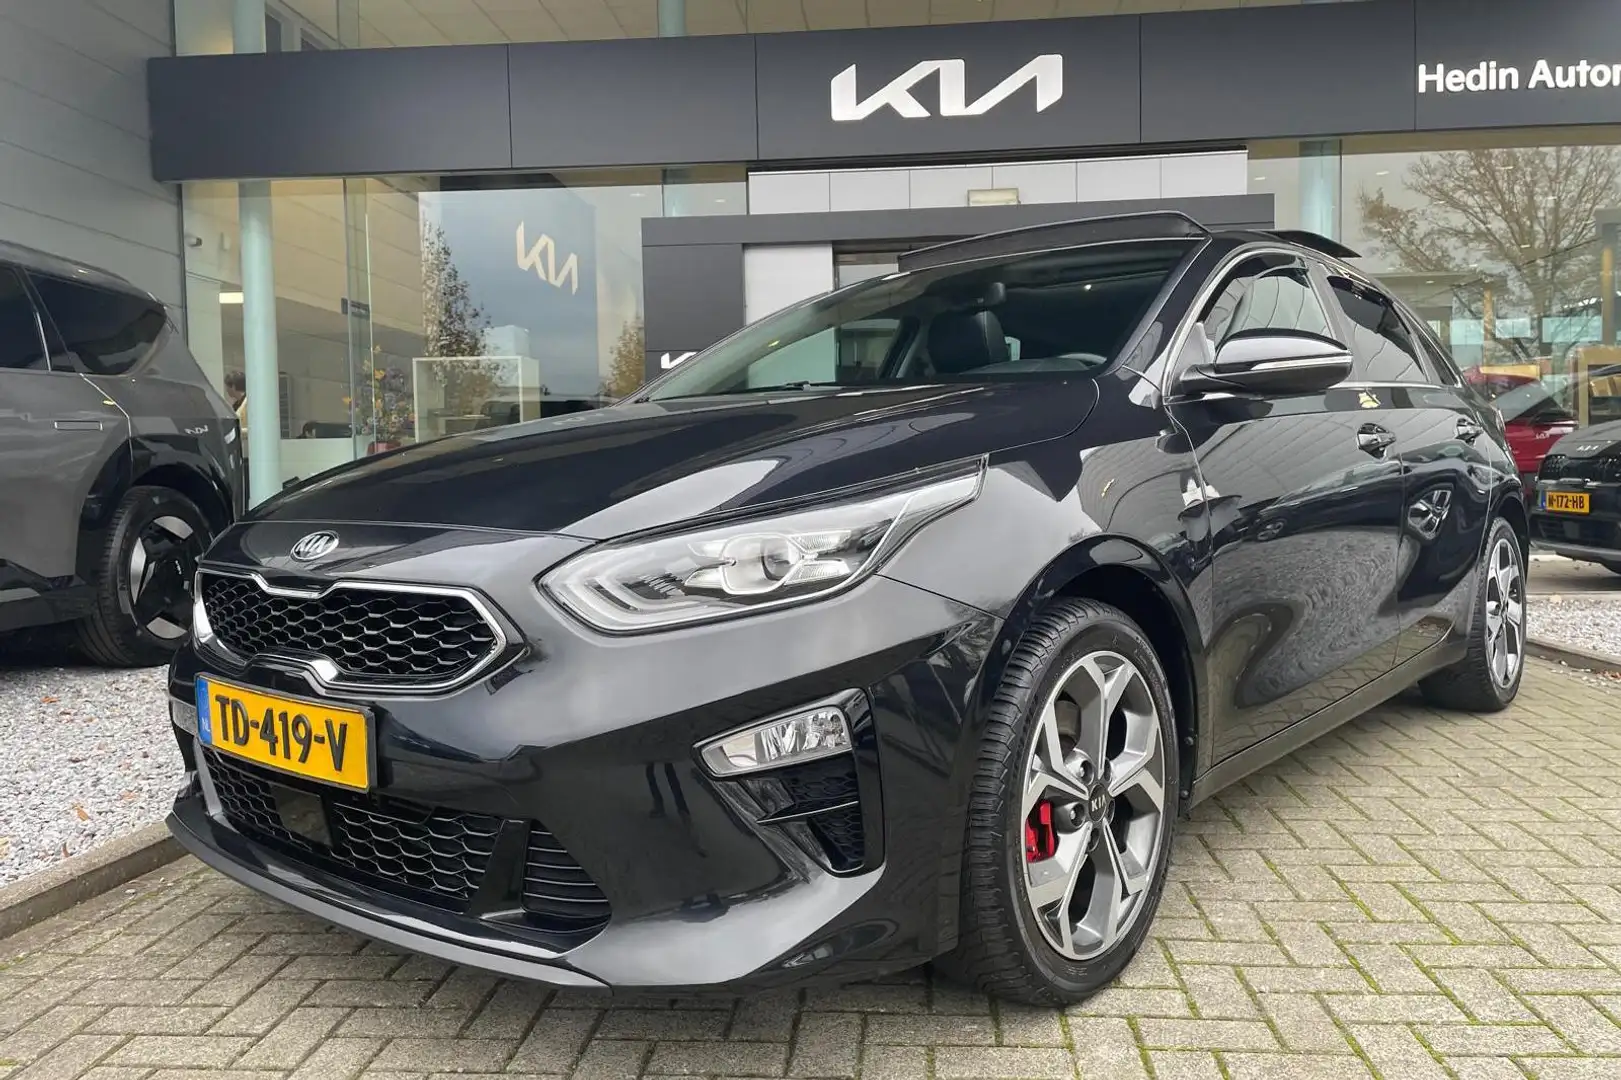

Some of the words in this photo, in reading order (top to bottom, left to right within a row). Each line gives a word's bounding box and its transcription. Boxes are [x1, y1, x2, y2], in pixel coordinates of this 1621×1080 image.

[831, 54, 1063, 121] KIA
[1418, 61, 1519, 93] Hedin
[516, 220, 578, 296] KIA
[215, 694, 348, 772] TD-419-V
[1091, 794, 1107, 812] KIA
